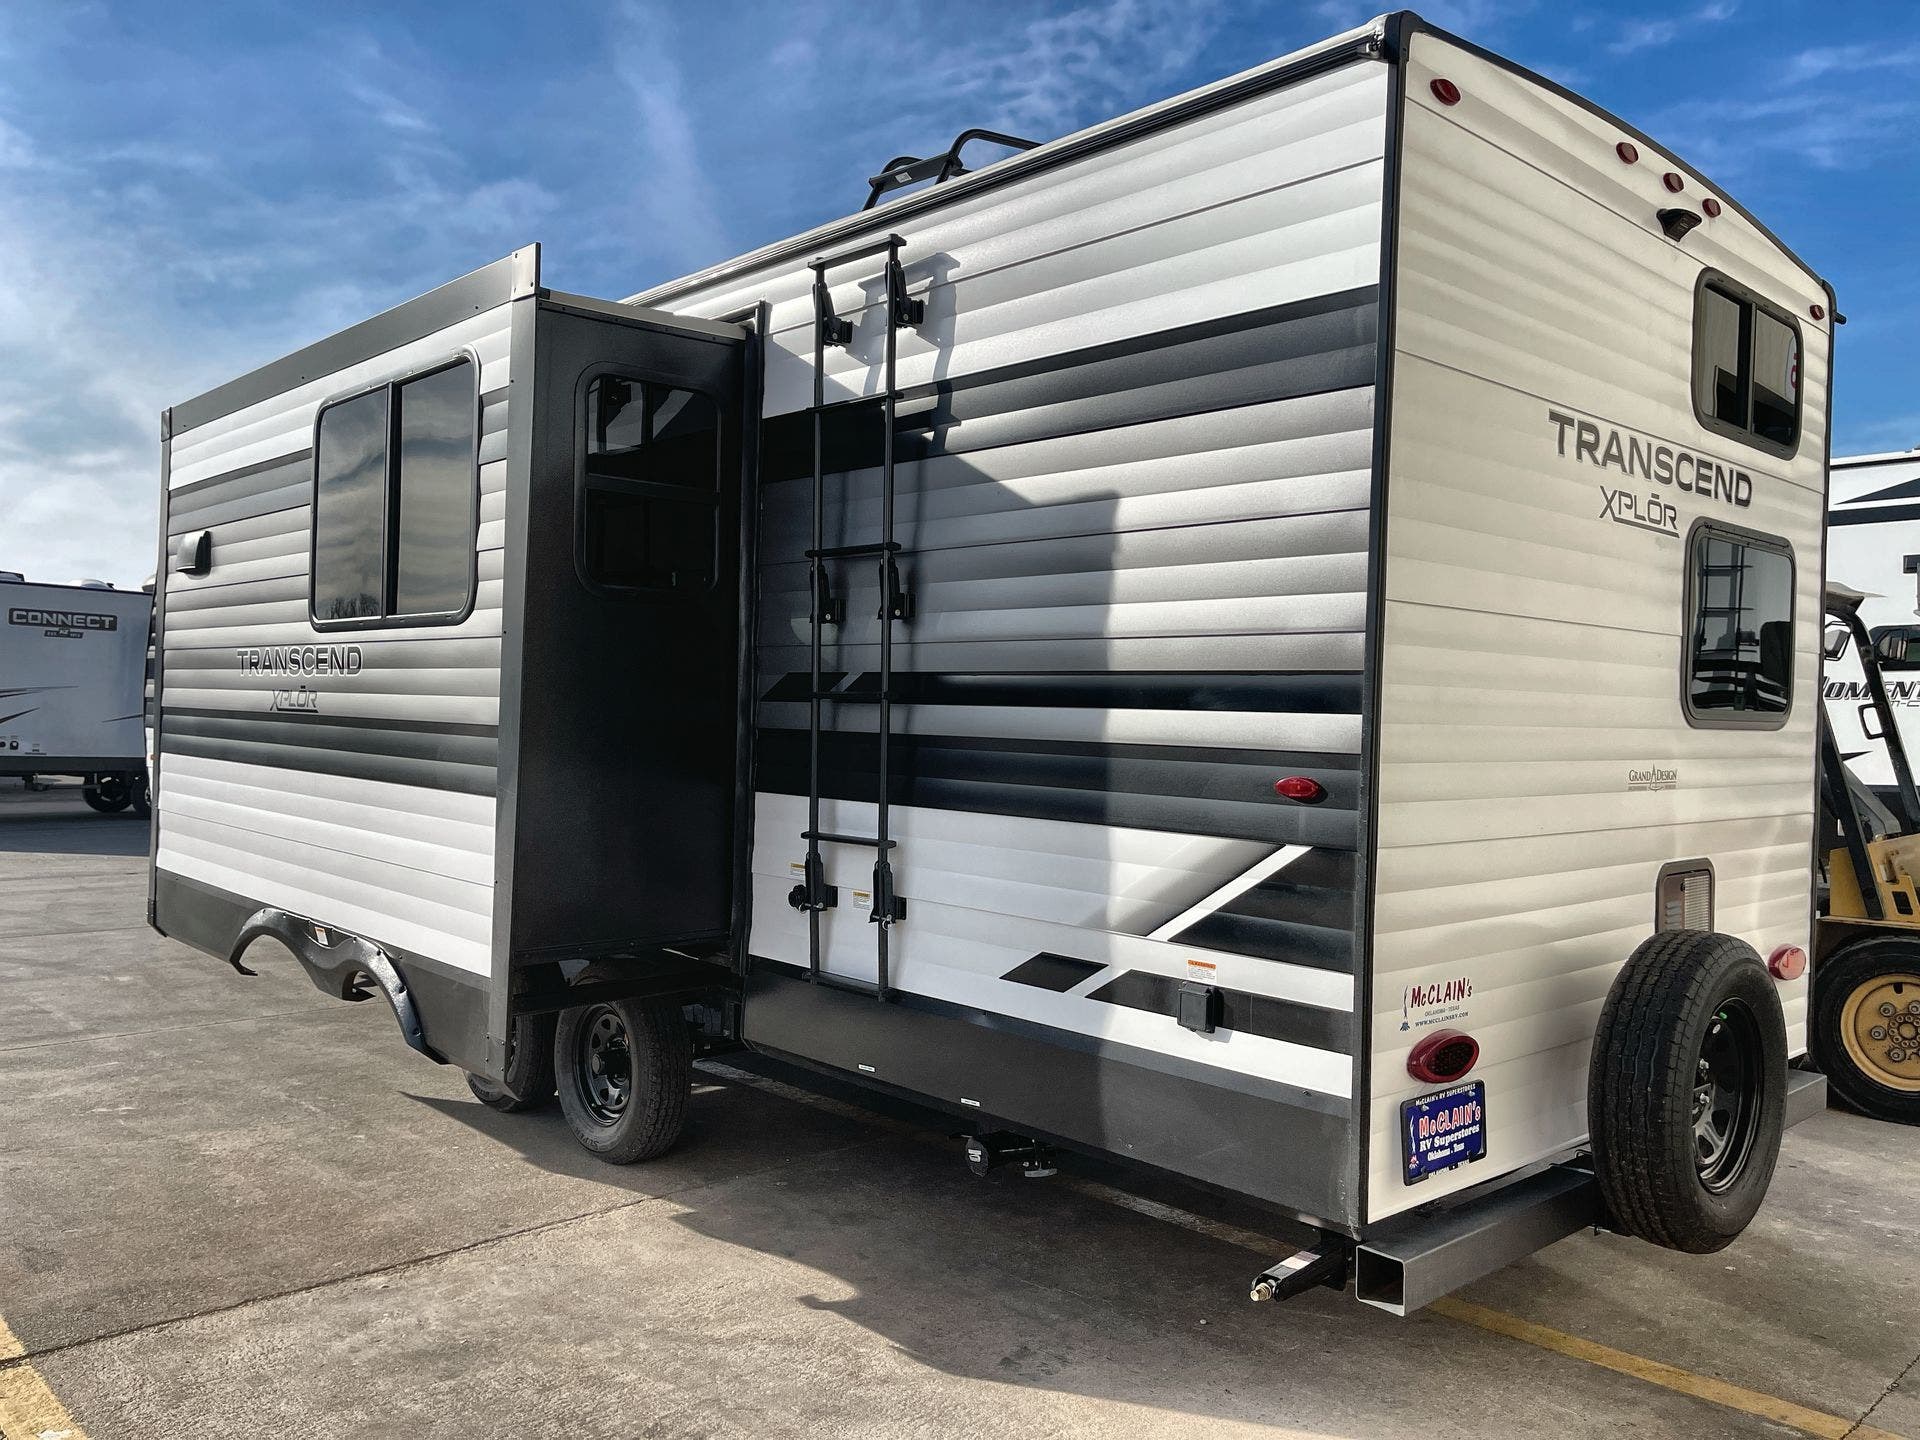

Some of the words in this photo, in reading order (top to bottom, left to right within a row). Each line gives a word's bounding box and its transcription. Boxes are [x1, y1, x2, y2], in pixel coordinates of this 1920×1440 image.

[1549, 408, 1752, 507] TRANSCEND
[12, 610, 114, 629] CONNECT
[236, 645, 362, 677] TRANSCEND
[1628, 769, 1651, 781] GRAND
[1656, 768, 1678, 780] DESIGN
[1419, 1138, 1432, 1152] RV
[1433, 1124, 1480, 1148] Superstores
